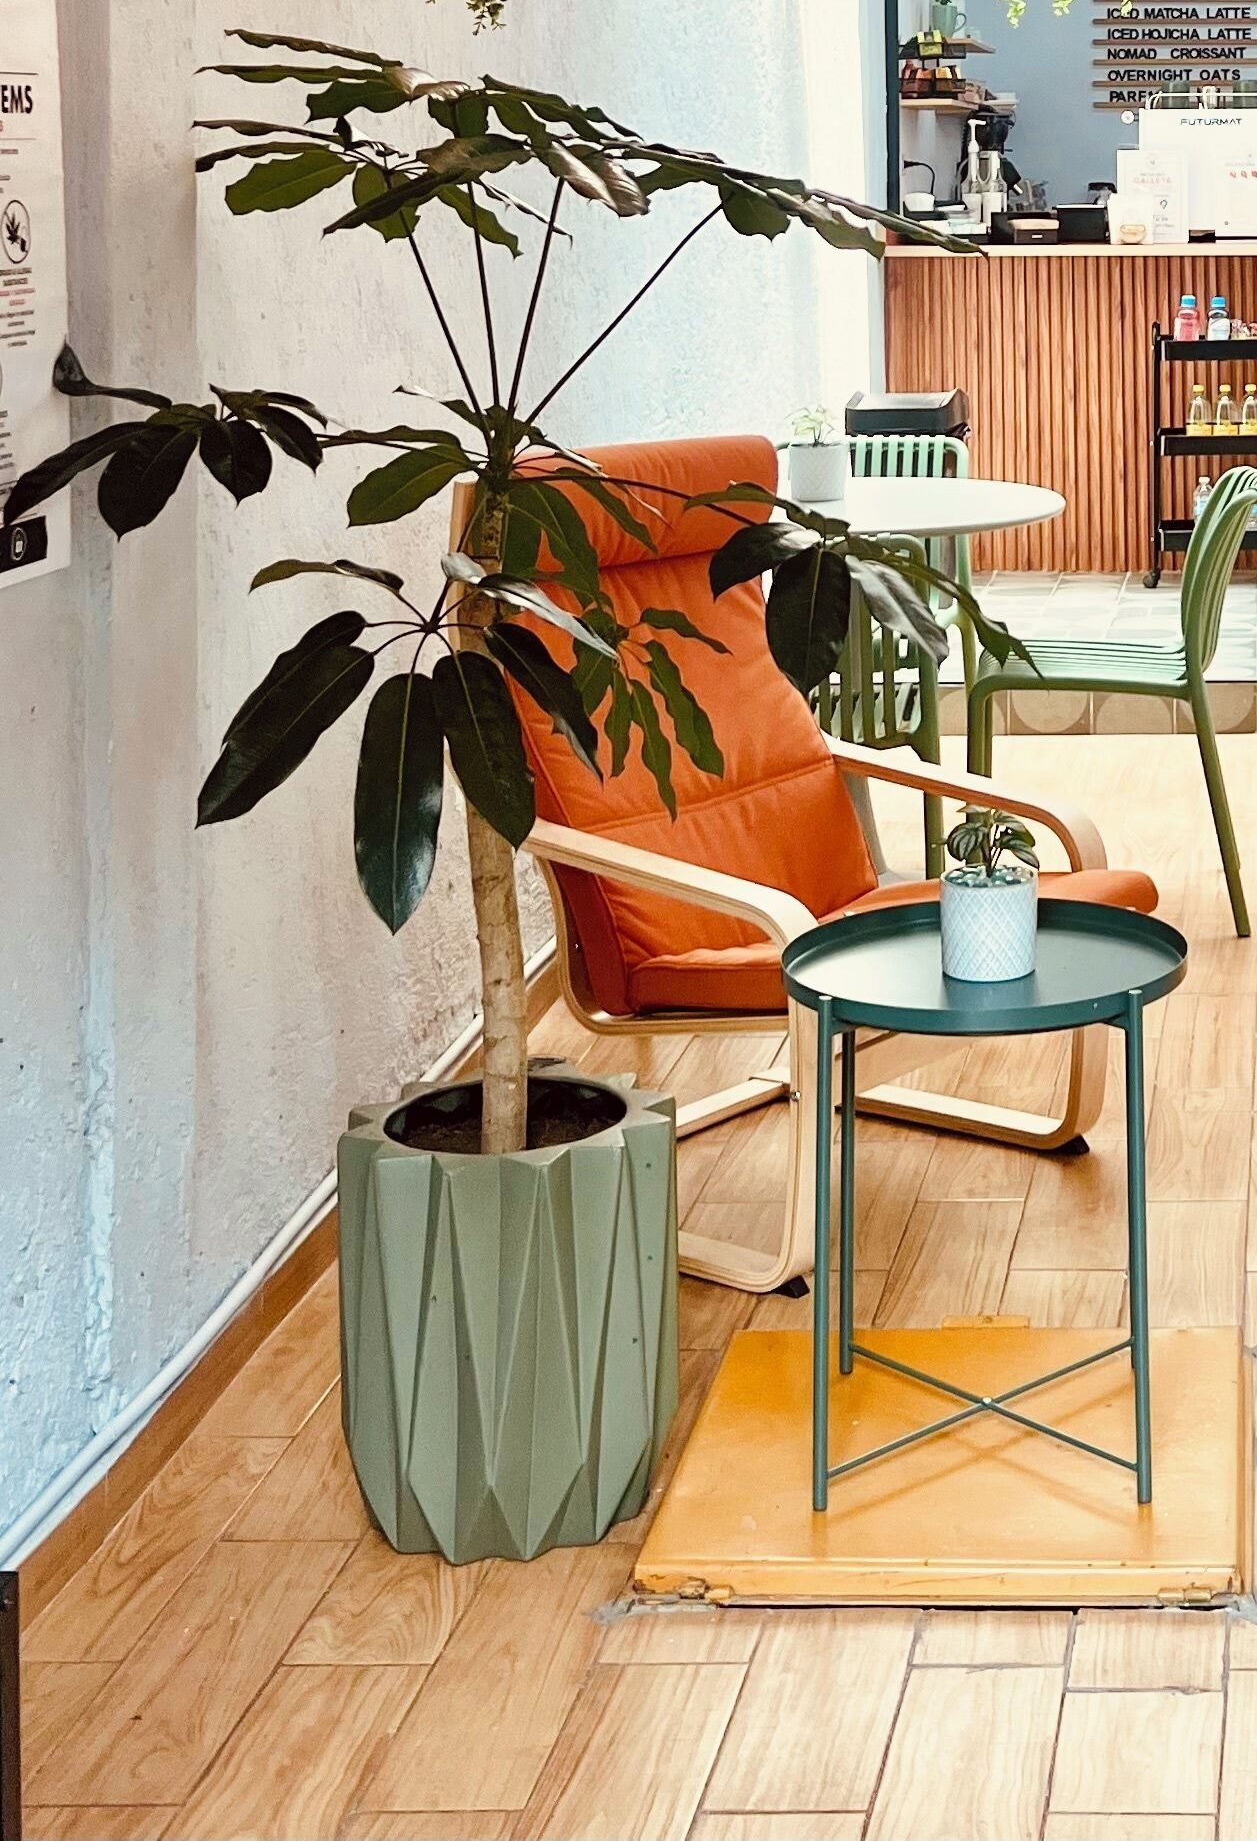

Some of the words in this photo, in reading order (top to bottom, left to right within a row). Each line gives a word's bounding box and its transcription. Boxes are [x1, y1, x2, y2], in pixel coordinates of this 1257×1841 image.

[1143, 7, 1200, 19] MATCHA
[1206, 7, 1251, 19] LATTE
[1107, 28, 1140, 40] ICED
[1142, 28, 1200, 40] HOJICHA
[1207, 28, 1252, 40] LATTE
[1107, 48, 1158, 60] NOMAD
[1170, 47, 1248, 59] CROISSANT
[1107, 69, 1193, 81] OVERNIGHT
[1199, 69, 1241, 81] OATS
[1181, 118, 1242, 126] FUTURMAT
